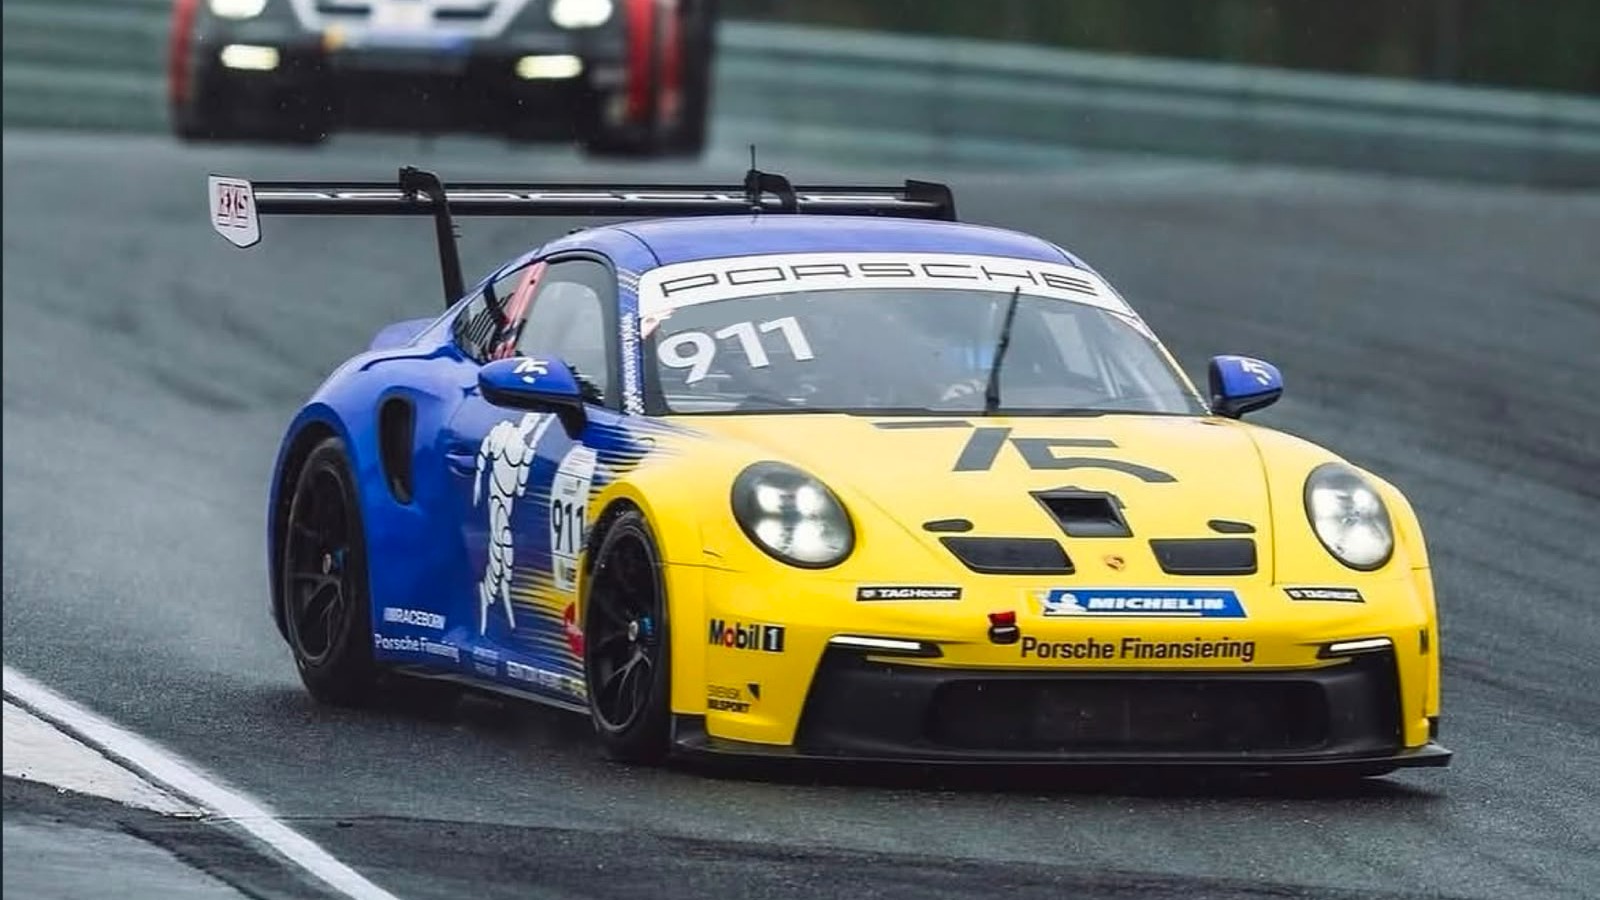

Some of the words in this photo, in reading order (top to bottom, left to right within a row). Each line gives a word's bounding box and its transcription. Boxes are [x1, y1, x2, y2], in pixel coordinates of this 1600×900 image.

[660, 262, 1098, 297] PORSCHE
[657, 316, 814, 385] 911
[872, 420, 1178, 483] 75
[552, 499, 585, 553] 911
[1087, 597, 1226, 610] MICHELIN
[373, 633, 419, 651] Porsche
[709, 618, 760, 651] Mobil
[765, 627, 782, 651] 1
[1020, 636, 1116, 659] Porsche
[1120, 636, 1257, 662] Finansiering
